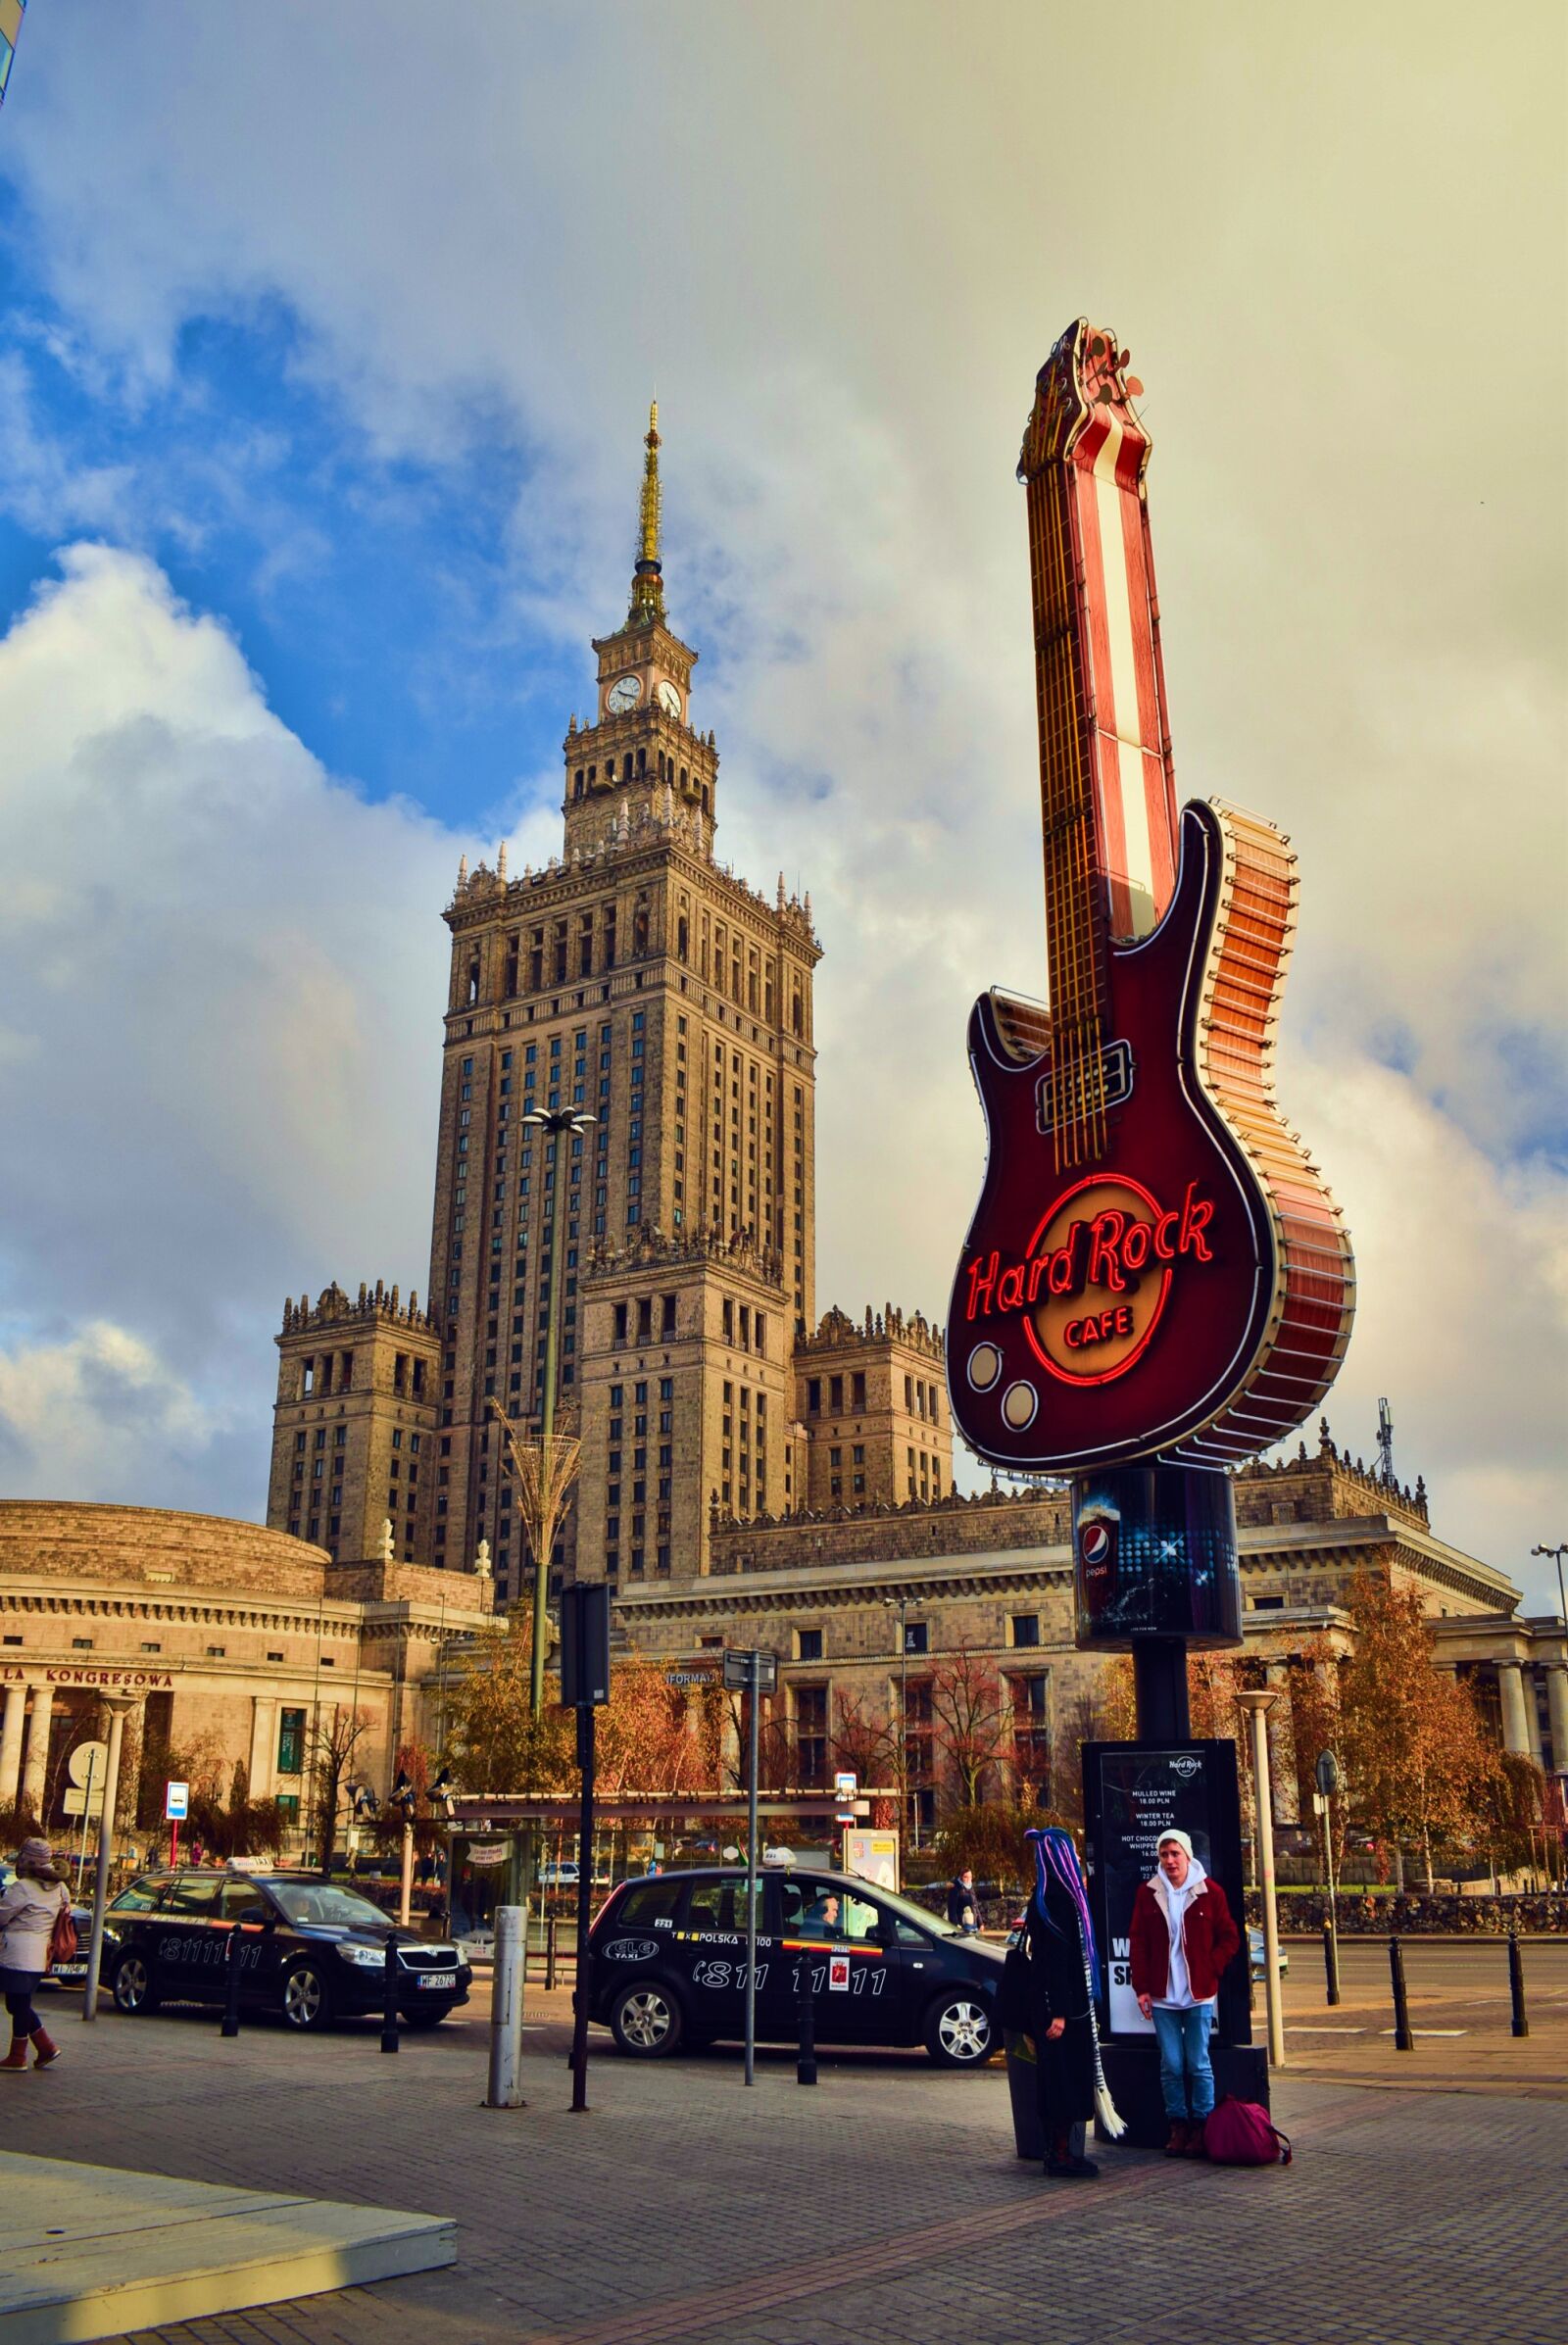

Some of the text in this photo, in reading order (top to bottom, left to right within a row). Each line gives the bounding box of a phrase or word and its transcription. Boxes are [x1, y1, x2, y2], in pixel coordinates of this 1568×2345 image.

[966, 1179, 1214, 1321] Hard Rock
[1064, 1305, 1130, 1348] CAFE
[1086, 1566, 1107, 1578] pepsi
[46, 1669, 172, 1686] KONGRESOWA
[699, 1933, 739, 1945] POLSKA
[702, 1961, 769, 1990] 811
